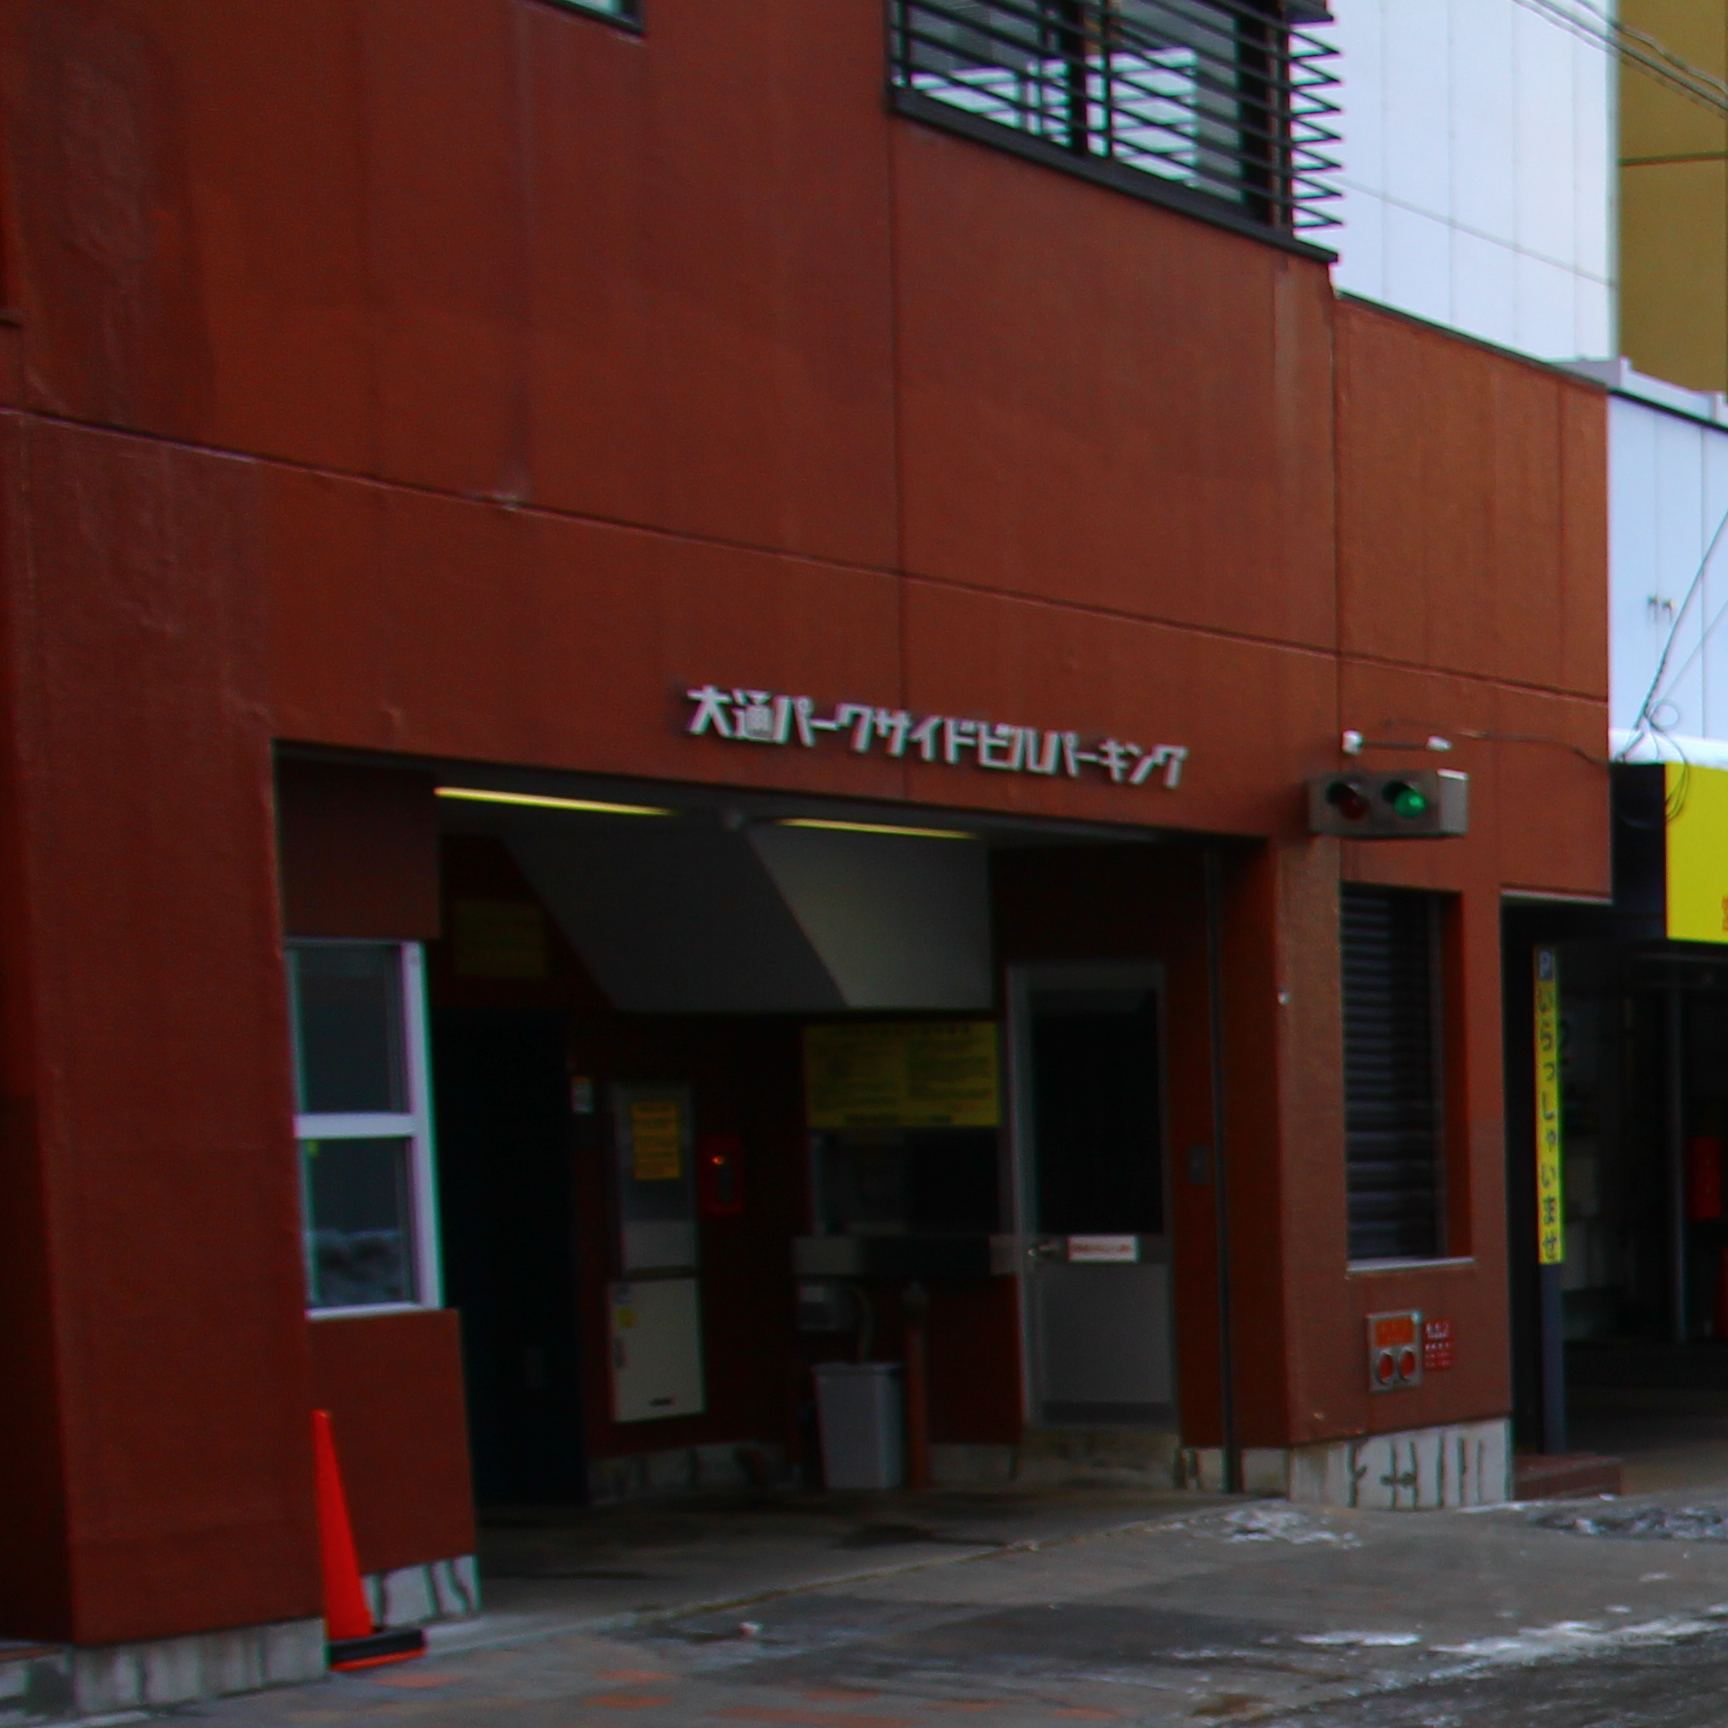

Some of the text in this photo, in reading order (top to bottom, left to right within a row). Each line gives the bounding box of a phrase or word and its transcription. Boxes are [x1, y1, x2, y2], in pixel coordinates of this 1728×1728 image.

[686, 684, 1189, 789] 大通パークサイドビルパーキング
